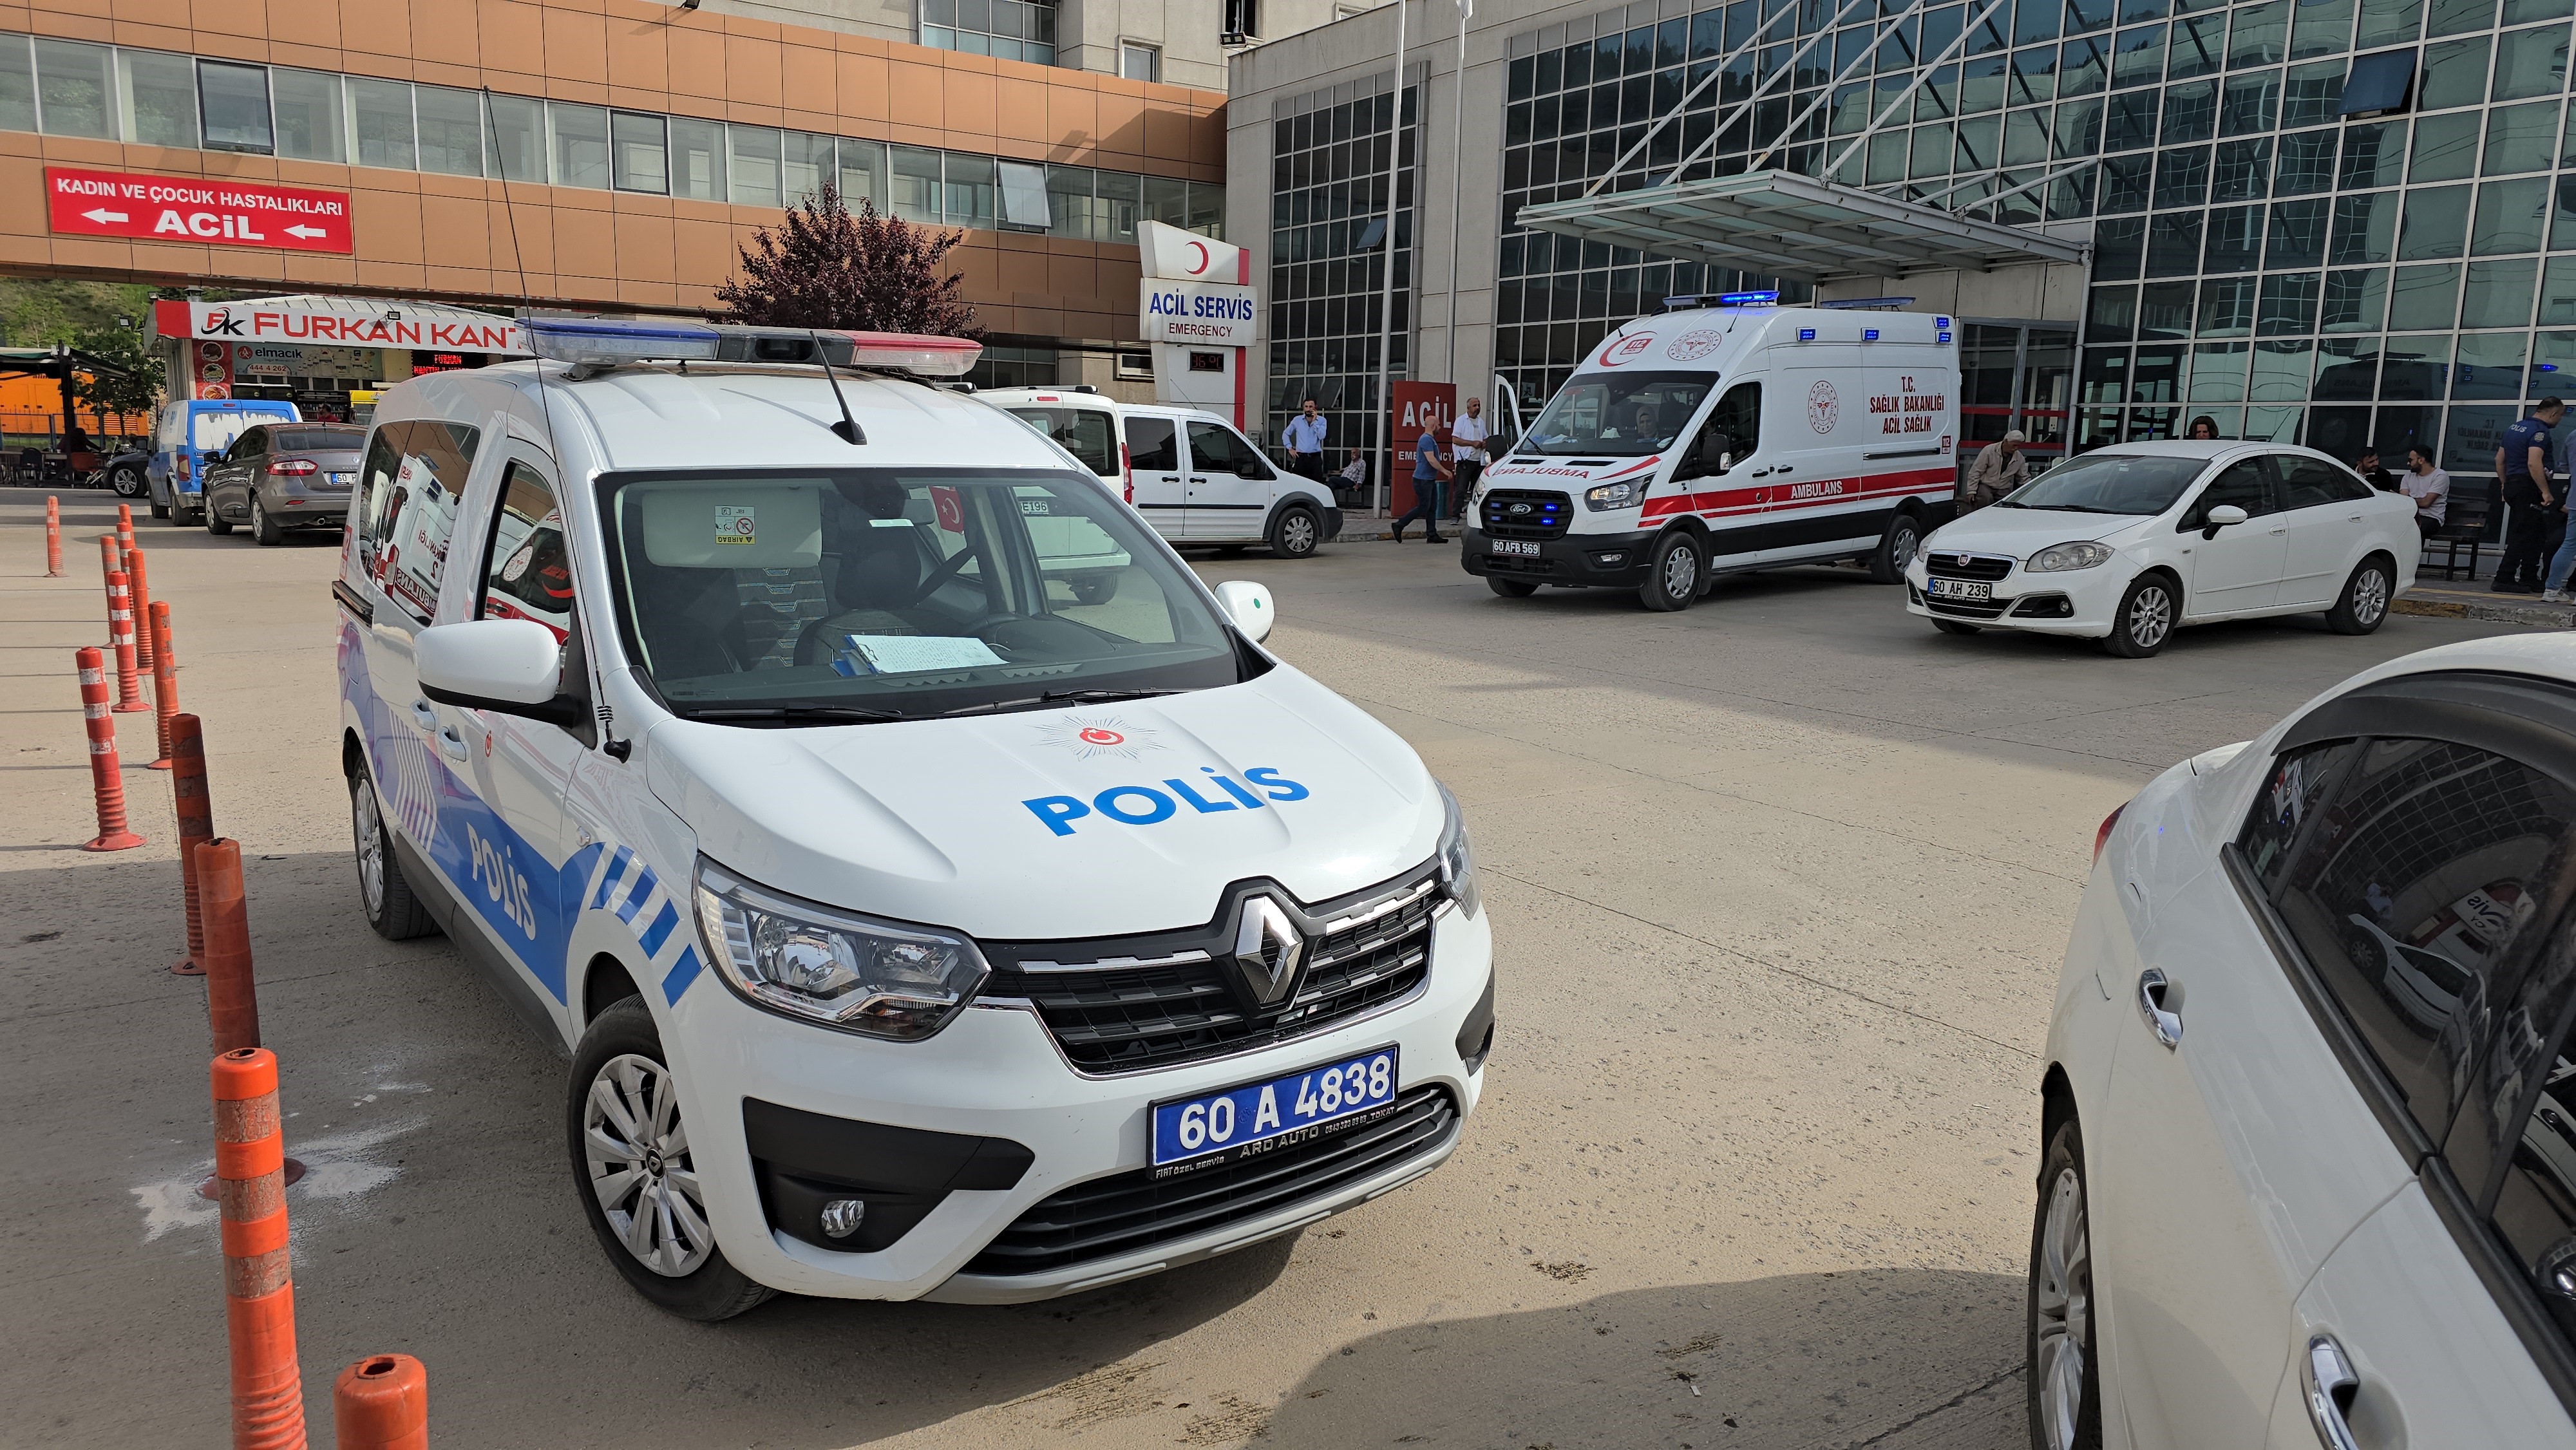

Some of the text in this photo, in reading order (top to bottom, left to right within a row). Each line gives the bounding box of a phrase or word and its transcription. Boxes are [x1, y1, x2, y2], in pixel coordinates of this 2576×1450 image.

[57, 178, 343, 216] KADIN VE ÇOCUK HASTALIKLARI
[1150, 288, 1253, 321] ACİL SERVİS
[254, 312, 522, 349] FURKAN KAN
[1169, 323, 1233, 337] EMERGENCY
[255, 347, 303, 359] elmacık
[1901, 376, 1916, 393] T.C.
[1870, 392, 1944, 413] SAĞLIK BAKANLIĞI
[1882, 413, 1932, 435] ACİL SAĞLIK
[1791, 480, 1843, 499] AMBULANS
[1494, 541, 1539, 554] 60 AFB 569
[1933, 580, 1989, 598] 60 AH 239
[1021, 766, 1310, 837] POLİS
[466, 822, 536, 941] POLİS
[1179, 1055, 1391, 1150] 60 A 4838
[1156, 1166, 1173, 1179] FIAT
[1173, 1163, 1195, 1175] ÖZEL
[1239, 1138, 1273, 1158] ARD
[1278, 1125, 1319, 1148] AUTO
[1370, 1106, 1395, 1120] TOKAT
